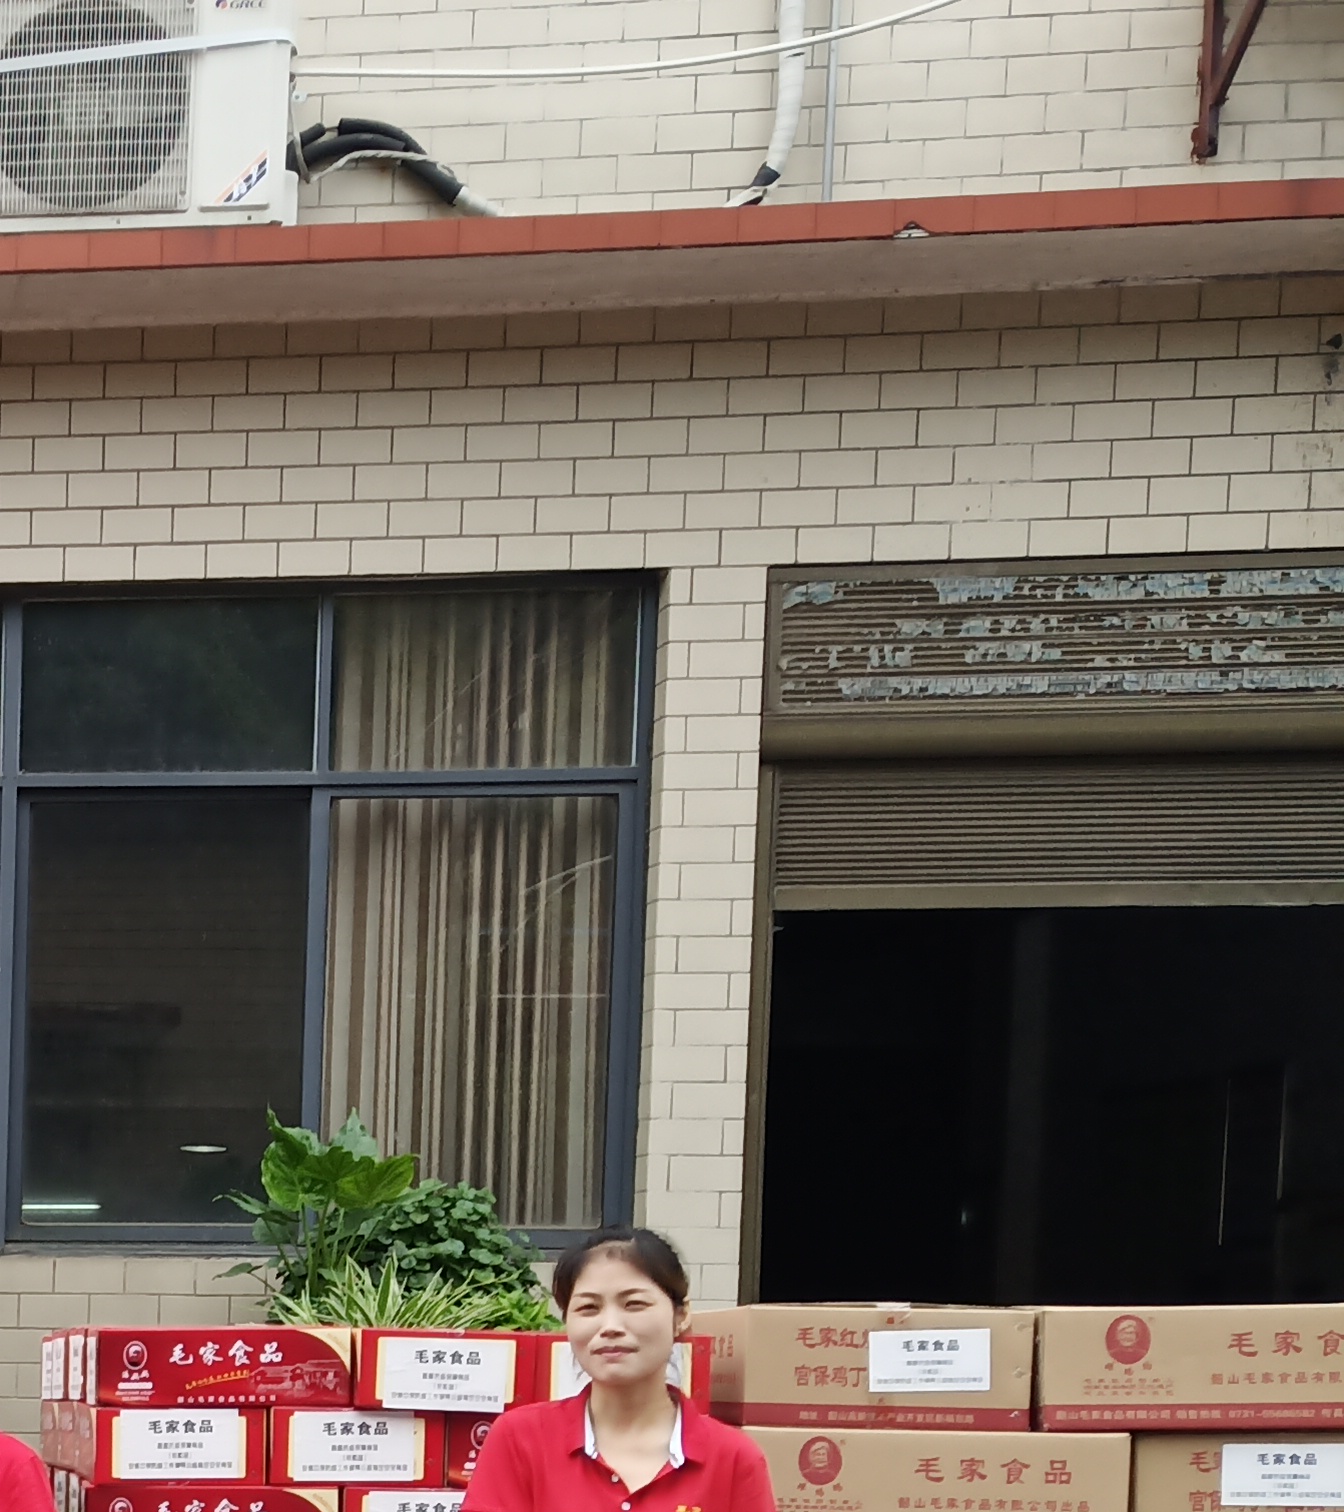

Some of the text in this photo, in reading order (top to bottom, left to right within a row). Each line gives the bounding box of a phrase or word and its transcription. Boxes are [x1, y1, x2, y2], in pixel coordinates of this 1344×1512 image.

[902, 1339, 960, 1352] 毛家食品
[1228, 1330, 1344, 1358] 毛家食
[169, 1340, 283, 1367] 毛家食品
[415, 1350, 481, 1365] 毛家食品
[794, 1365, 867, 1388] 宫保鸡丁
[148, 1420, 213, 1434] 毛家食品
[323, 1421, 388, 1436] 毛家食品
[1257, 1453, 1317, 1466] 毛家食品
[914, 1456, 1073, 1485] 毛家食品
